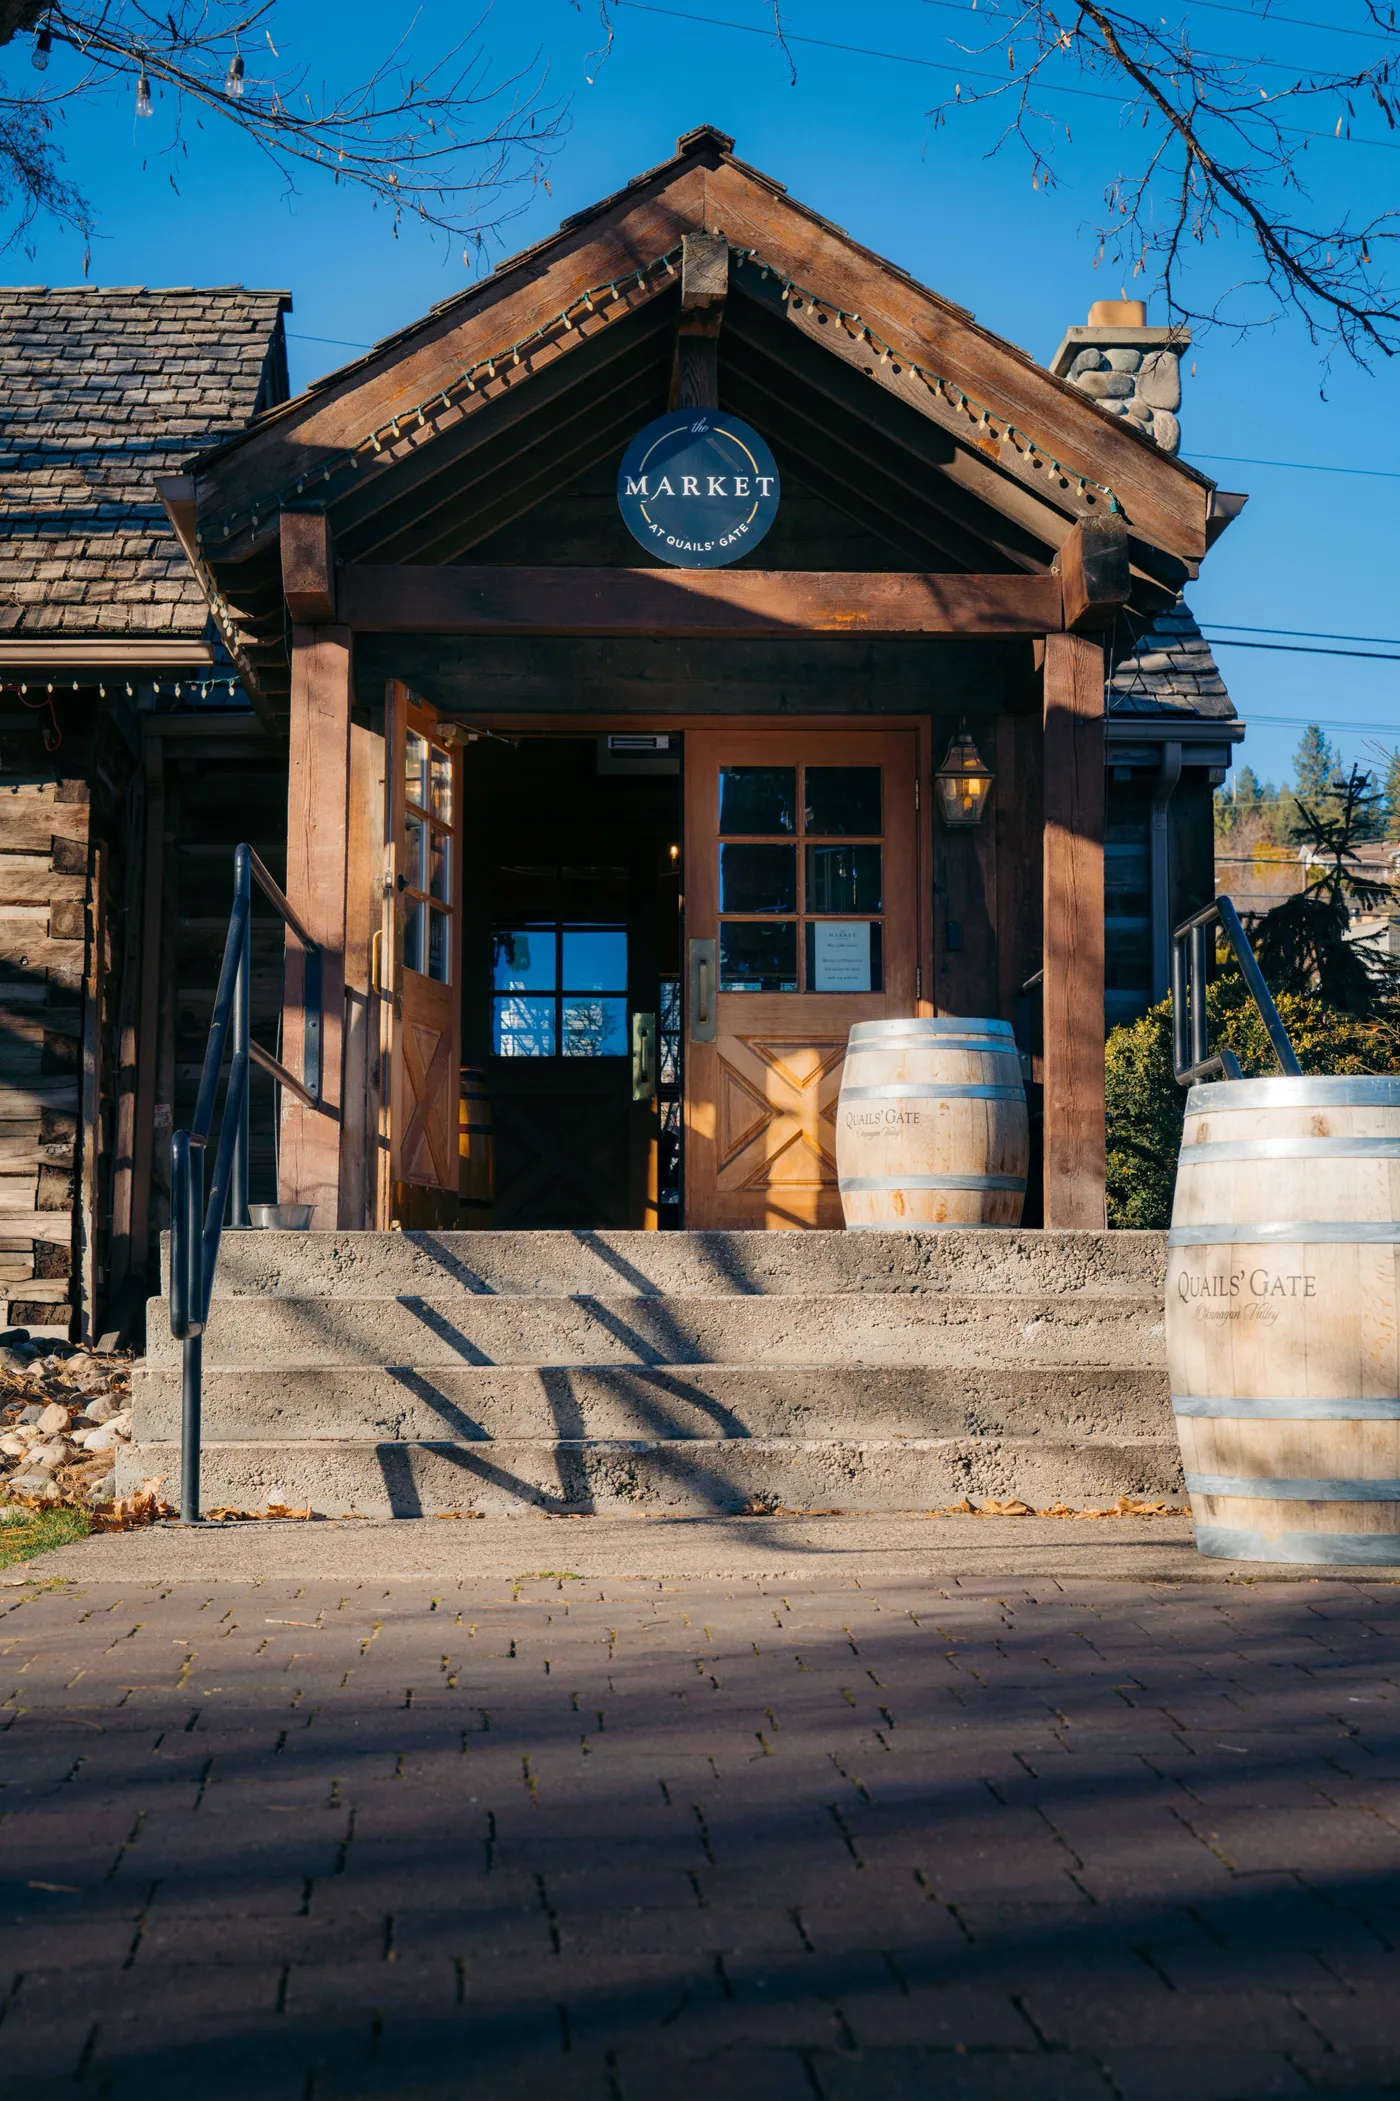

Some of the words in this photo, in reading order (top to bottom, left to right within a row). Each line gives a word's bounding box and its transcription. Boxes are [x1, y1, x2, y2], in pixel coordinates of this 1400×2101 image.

[690, 417, 709, 433] the
[624, 475, 775, 501] MARKET
[648, 523, 665, 537] AT
[666, 535, 715, 552] QUAILS'
[719, 522, 749, 547] GATE
[845, 1109, 883, 1130] QUAILS'
[885, 1108, 920, 1124] GATE
[1177, 1269, 1245, 1304] QUAILS'
[1249, 1268, 1317, 1297] GATE
[1195, 1302, 1241, 1327] Okanagan
[1243, 1302, 1280, 1327] Valley
